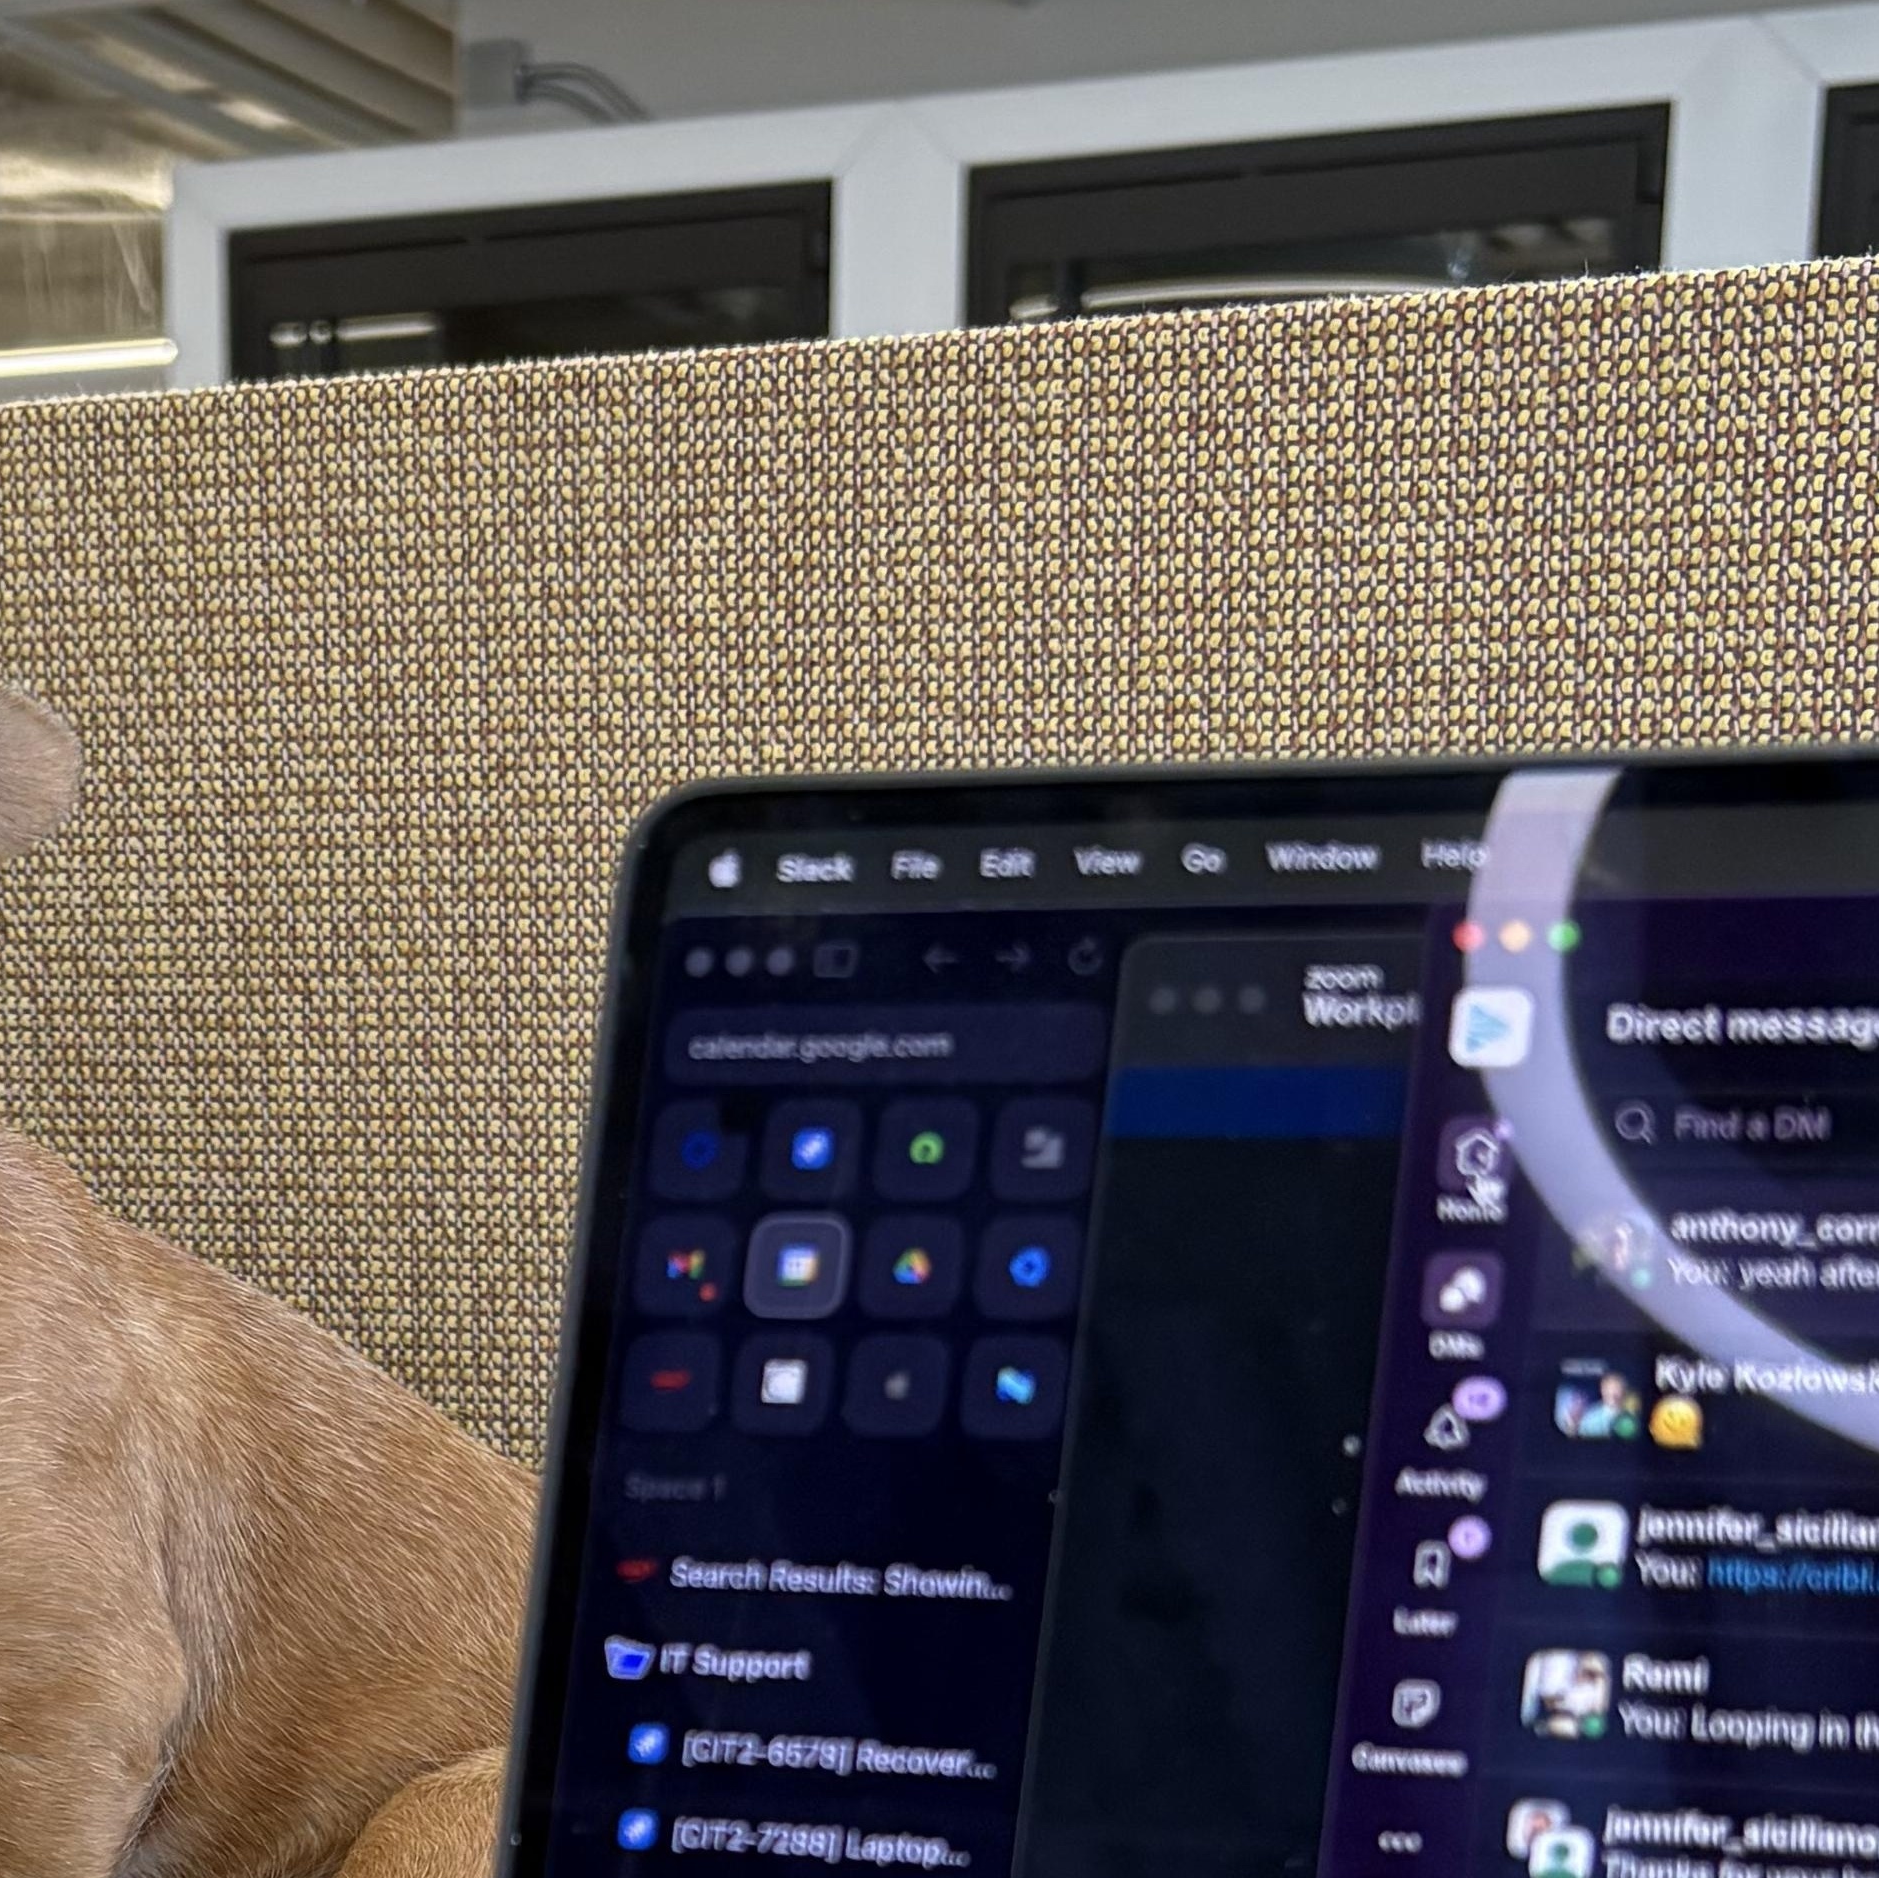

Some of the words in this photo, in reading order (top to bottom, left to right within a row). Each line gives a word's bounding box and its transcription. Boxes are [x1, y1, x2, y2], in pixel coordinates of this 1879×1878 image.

[777, 853, 854, 882] Slack
[890, 850, 942, 880] File
[979, 848, 1036, 878] Edit
[1074, 847, 1143, 876] View
[1181, 843, 1227, 873] Go
[1265, 840, 1381, 872] Window
[1304, 964, 1384, 990] zoom
[1606, 1003, 1722, 1044] Direct
[1725, 1006, 1879, 1049] messag
[688, 1031, 955, 1063] calendar.google.com
[1675, 1105, 1741, 1142] Find
[1747, 1111, 1769, 1142] a
[1773, 1105, 1832, 1142] DM
[1738, 1255, 1816, 1290] yeah
[1655, 1355, 1728, 1394] Kyle
[1395, 1466, 1488, 1503] Activity
[670, 1555, 768, 1590] Search
[769, 1559, 880, 1595] Results:
[883, 1562, 1013, 1600] Showin...
[1634, 1550, 1703, 1589] You:
[1708, 1553, 1879, 1595] https://cribl.
[1393, 1605, 1459, 1638] Later
[659, 1642, 691, 1675] IT
[692, 1643, 812, 1682] Support
[1618, 1700, 1688, 1740] You:
[1691, 1702, 1816, 1754] Looping
[1818, 1707, 1850, 1750] in
[856, 1739, 998, 1779] Recover...
[1352, 1741, 1468, 1779] Canvases
[846, 1827, 971, 1870] Laptop...
